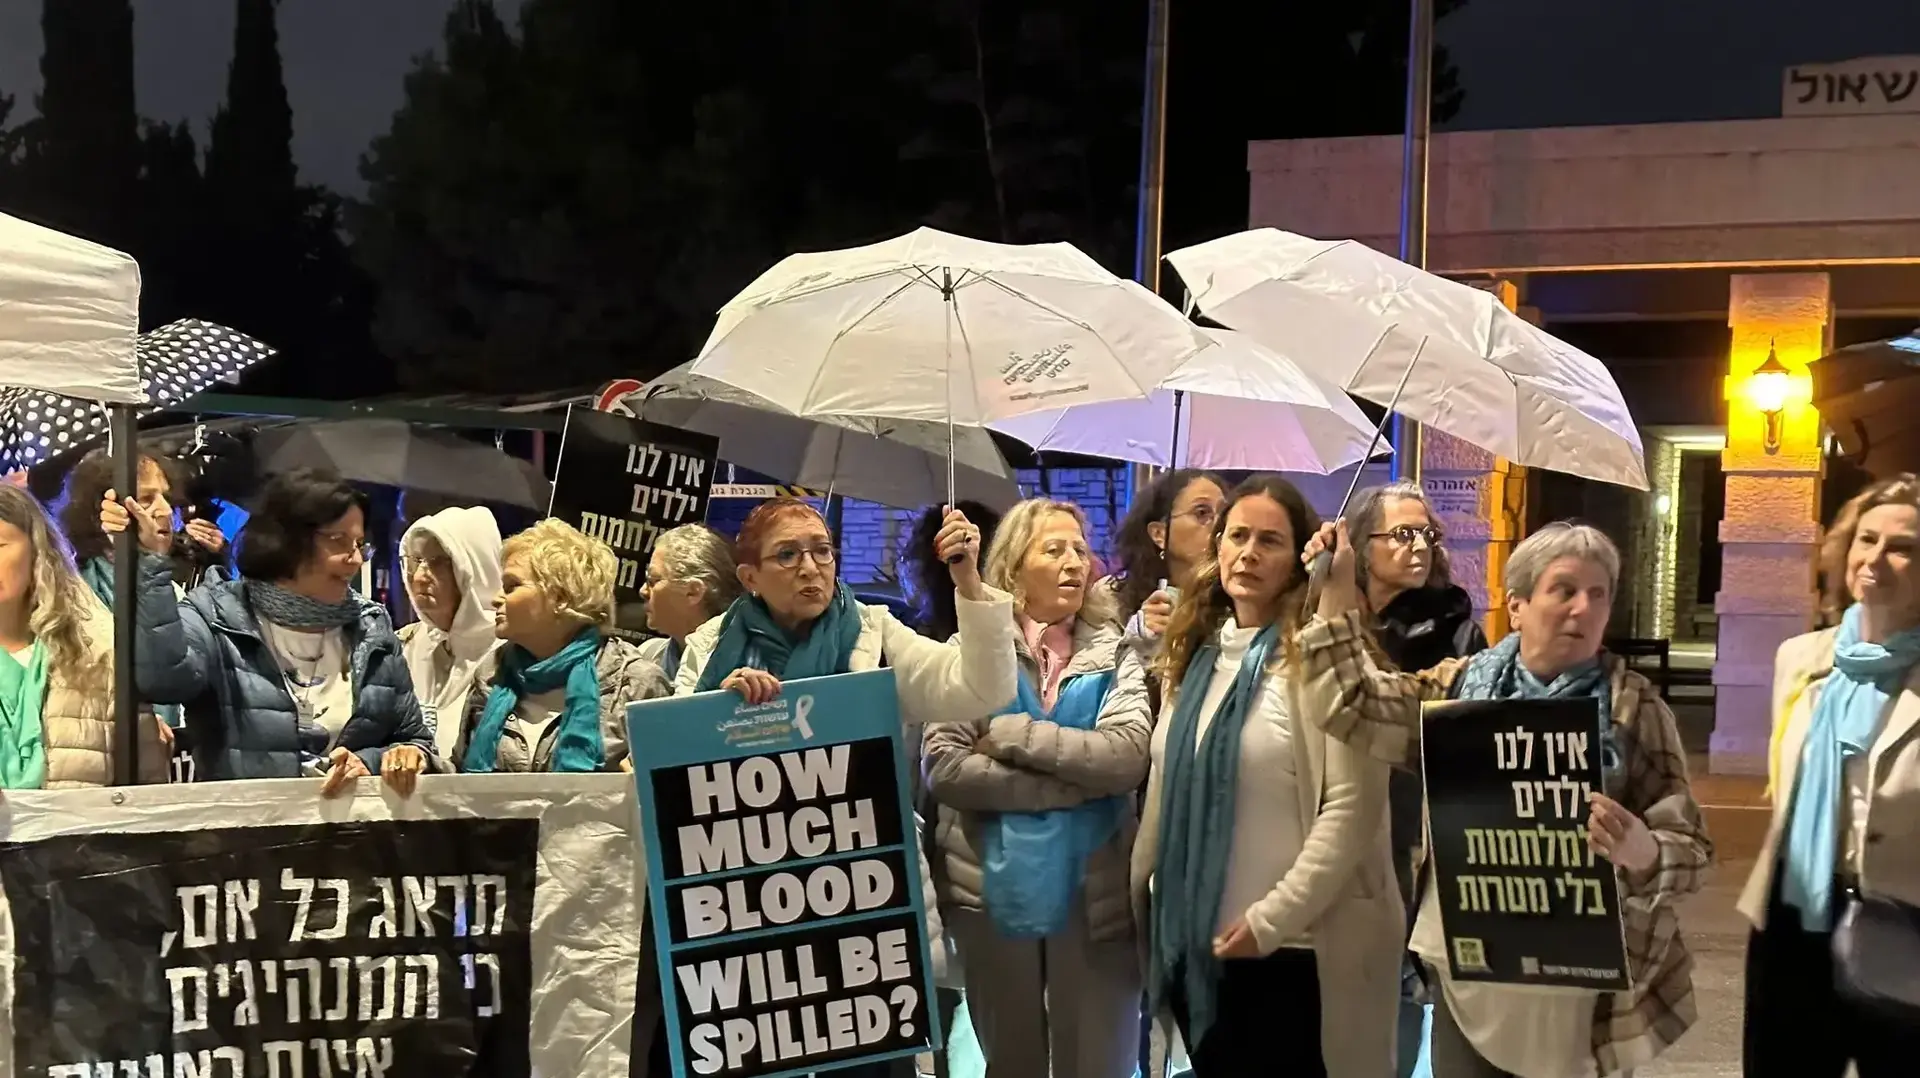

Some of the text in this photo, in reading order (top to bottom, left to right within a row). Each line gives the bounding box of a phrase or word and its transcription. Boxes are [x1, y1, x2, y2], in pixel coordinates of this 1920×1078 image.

[1791, 69, 1918, 103] שאול
[625, 443, 705, 487] אין לנו
[1427, 480, 1476, 490] אזהרה
[581, 511, 665, 553] לחמות
[631, 483, 698, 521] ילדים
[687, 744, 852, 817] HOW
[1494, 725, 1589, 776] אין לנו
[1512, 774, 1592, 819] ילדים
[678, 798, 878, 877] MUCH
[159, 878, 260, 958] אם,
[280, 867, 351, 942] כל
[682, 859, 894, 939] BLOOD
[1456, 871, 1607, 916] בלי מטרות
[163, 952, 502, 1036] כי המנהיגים
[677, 928, 911, 1015] WILL BE
[688, 984, 918, 1075] SPILLED?
